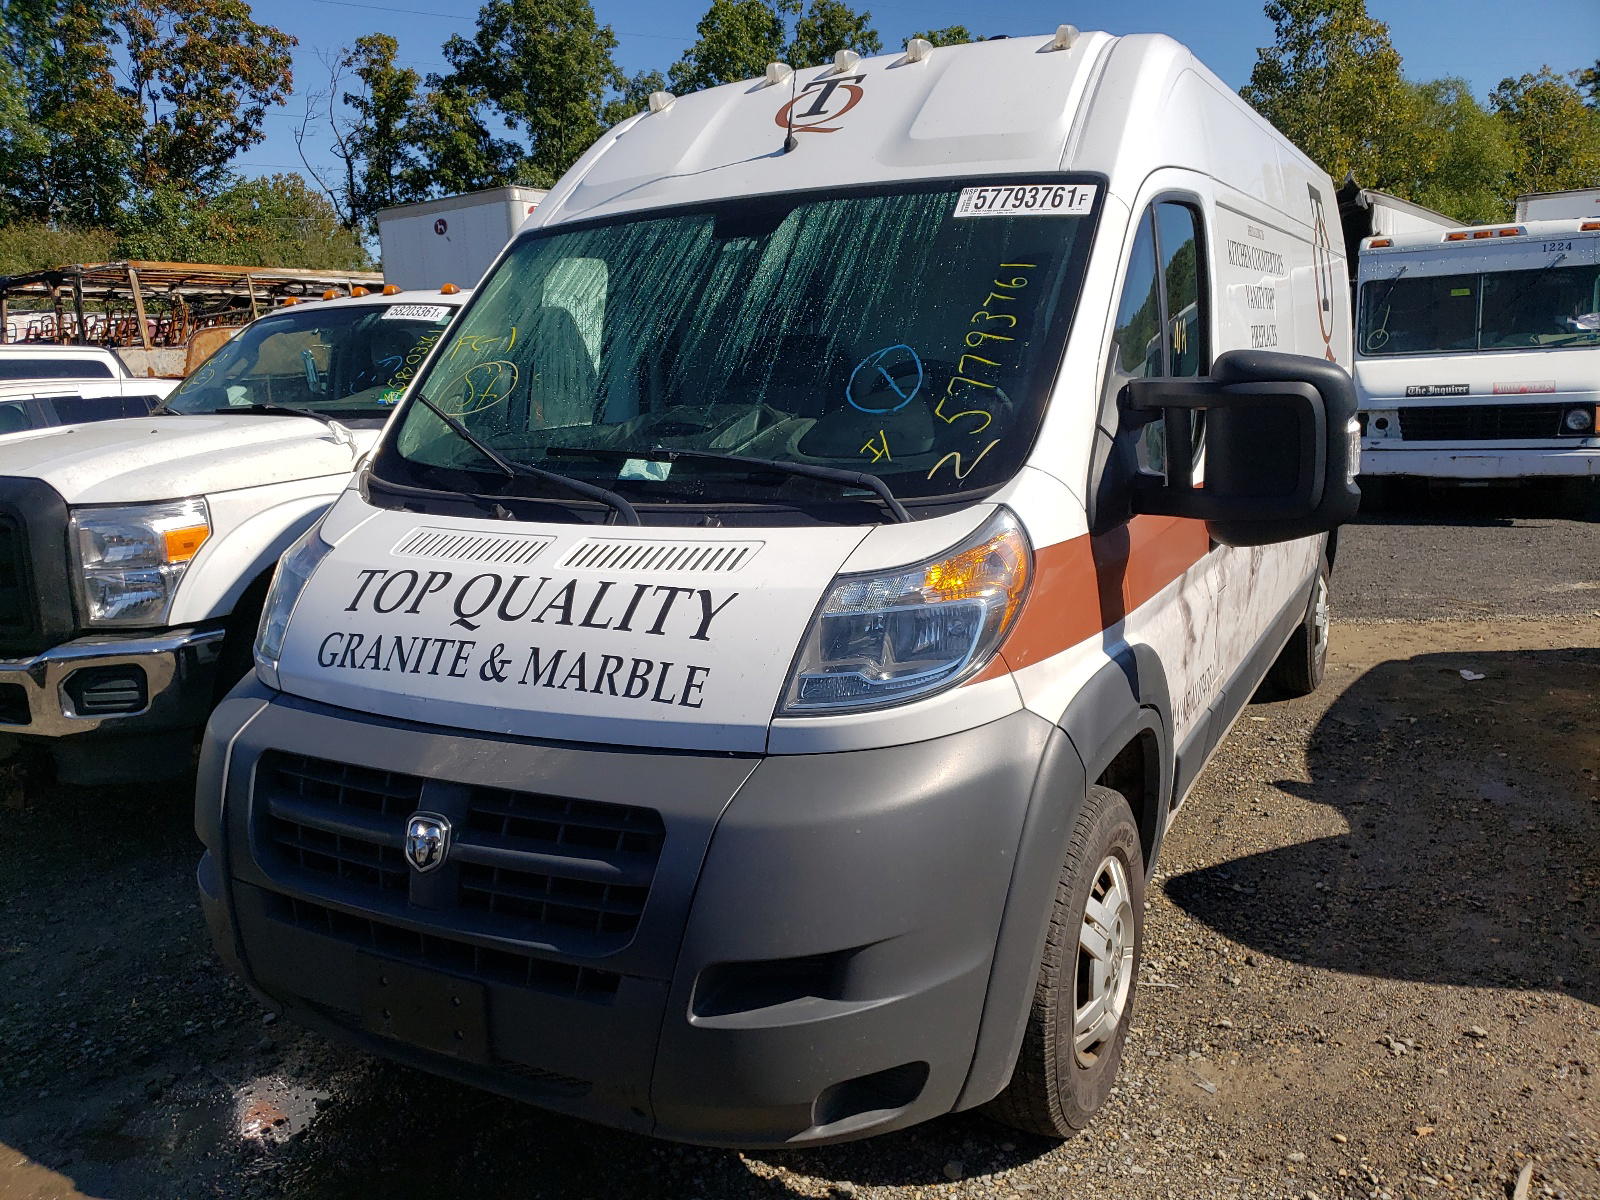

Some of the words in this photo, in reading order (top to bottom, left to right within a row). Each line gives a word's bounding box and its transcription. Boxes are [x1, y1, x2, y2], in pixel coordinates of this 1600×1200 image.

[974, 186, 1078, 210] 57793761
[1227, 239, 1252, 269] KITCHEN
[1542, 241, 1572, 252] 1224
[934, 262, 1037, 435] 57793761
[1250, 324, 1278, 349] FIREPLACES
[1407, 386, 1426, 395] The
[1428, 384, 1469, 395] Inquirer
[344, 569, 451, 614] TOP
[450, 572, 739, 642] QUALITY
[317, 631, 476, 678] GRANITE
[479, 642, 513, 683] &
[518, 646, 711, 709] MARBLE
